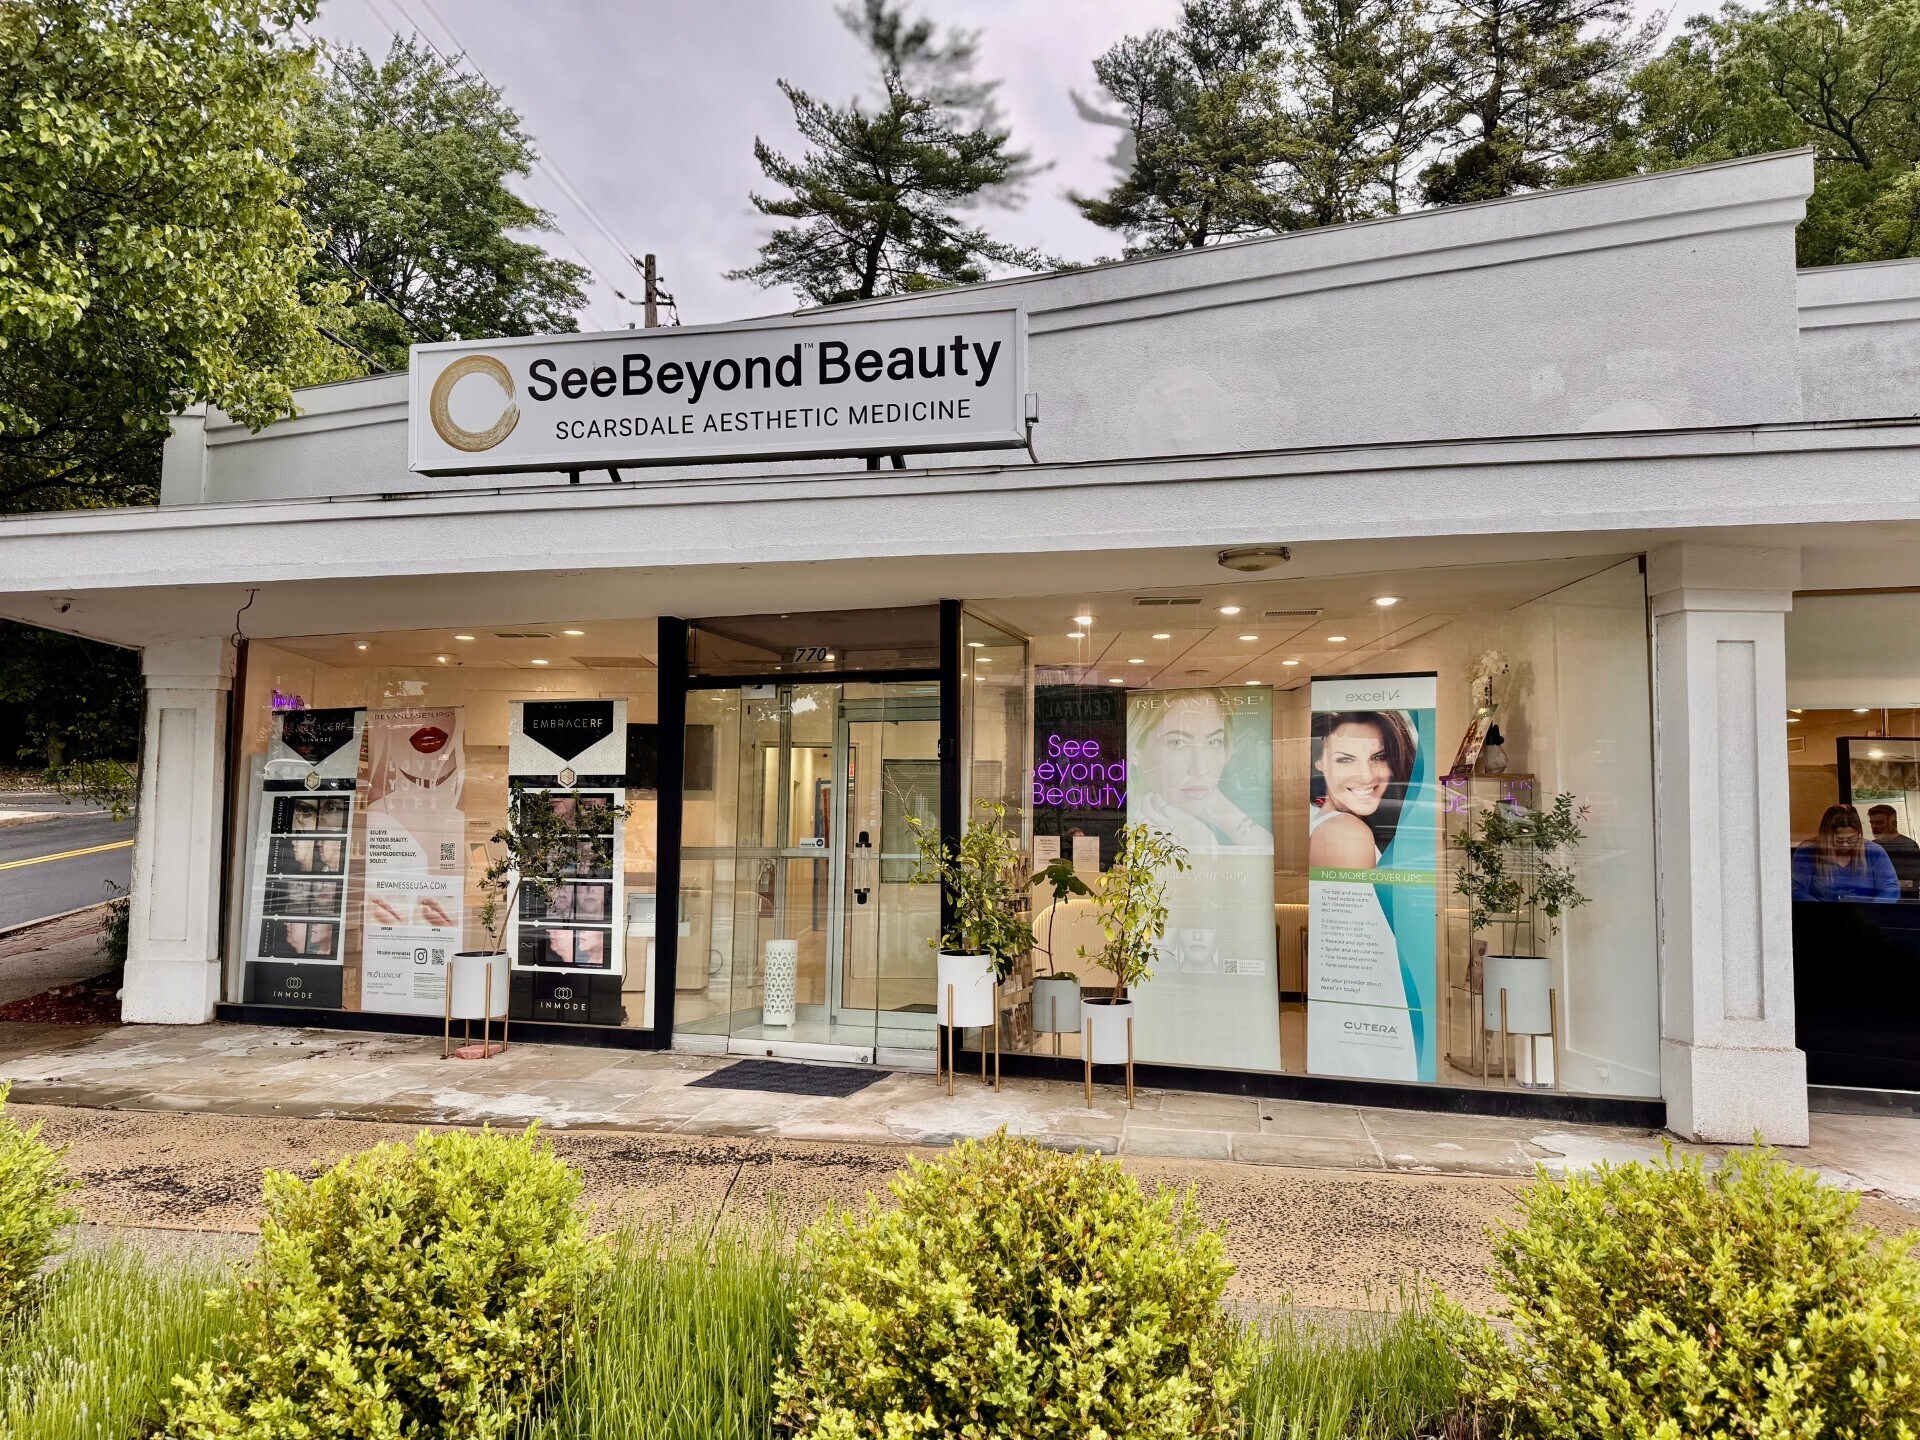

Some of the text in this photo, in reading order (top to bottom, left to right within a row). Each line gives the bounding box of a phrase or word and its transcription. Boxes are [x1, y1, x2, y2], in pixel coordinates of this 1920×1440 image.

[818, 335, 1002, 387] Beauty
[556, 398, 971, 440] SCARSDALE AESTHETIC MEDICINE
[794, 647, 828, 663] 770
[533, 718, 603, 729] EMBRACERF
[1048, 734, 1100, 758] See
[388, 760, 438, 772] LOVE
[1033, 759, 1126, 784] eyond
[388, 779, 437, 791] YOUR
[1033, 782, 1127, 808] Beauty
[1321, 870, 1424, 884] NO MORE COVER UPS.
[376, 881, 447, 890] REVANESSEUSA.COM
[273, 990, 313, 999] INMODE
[540, 1001, 586, 1011] INMODE
